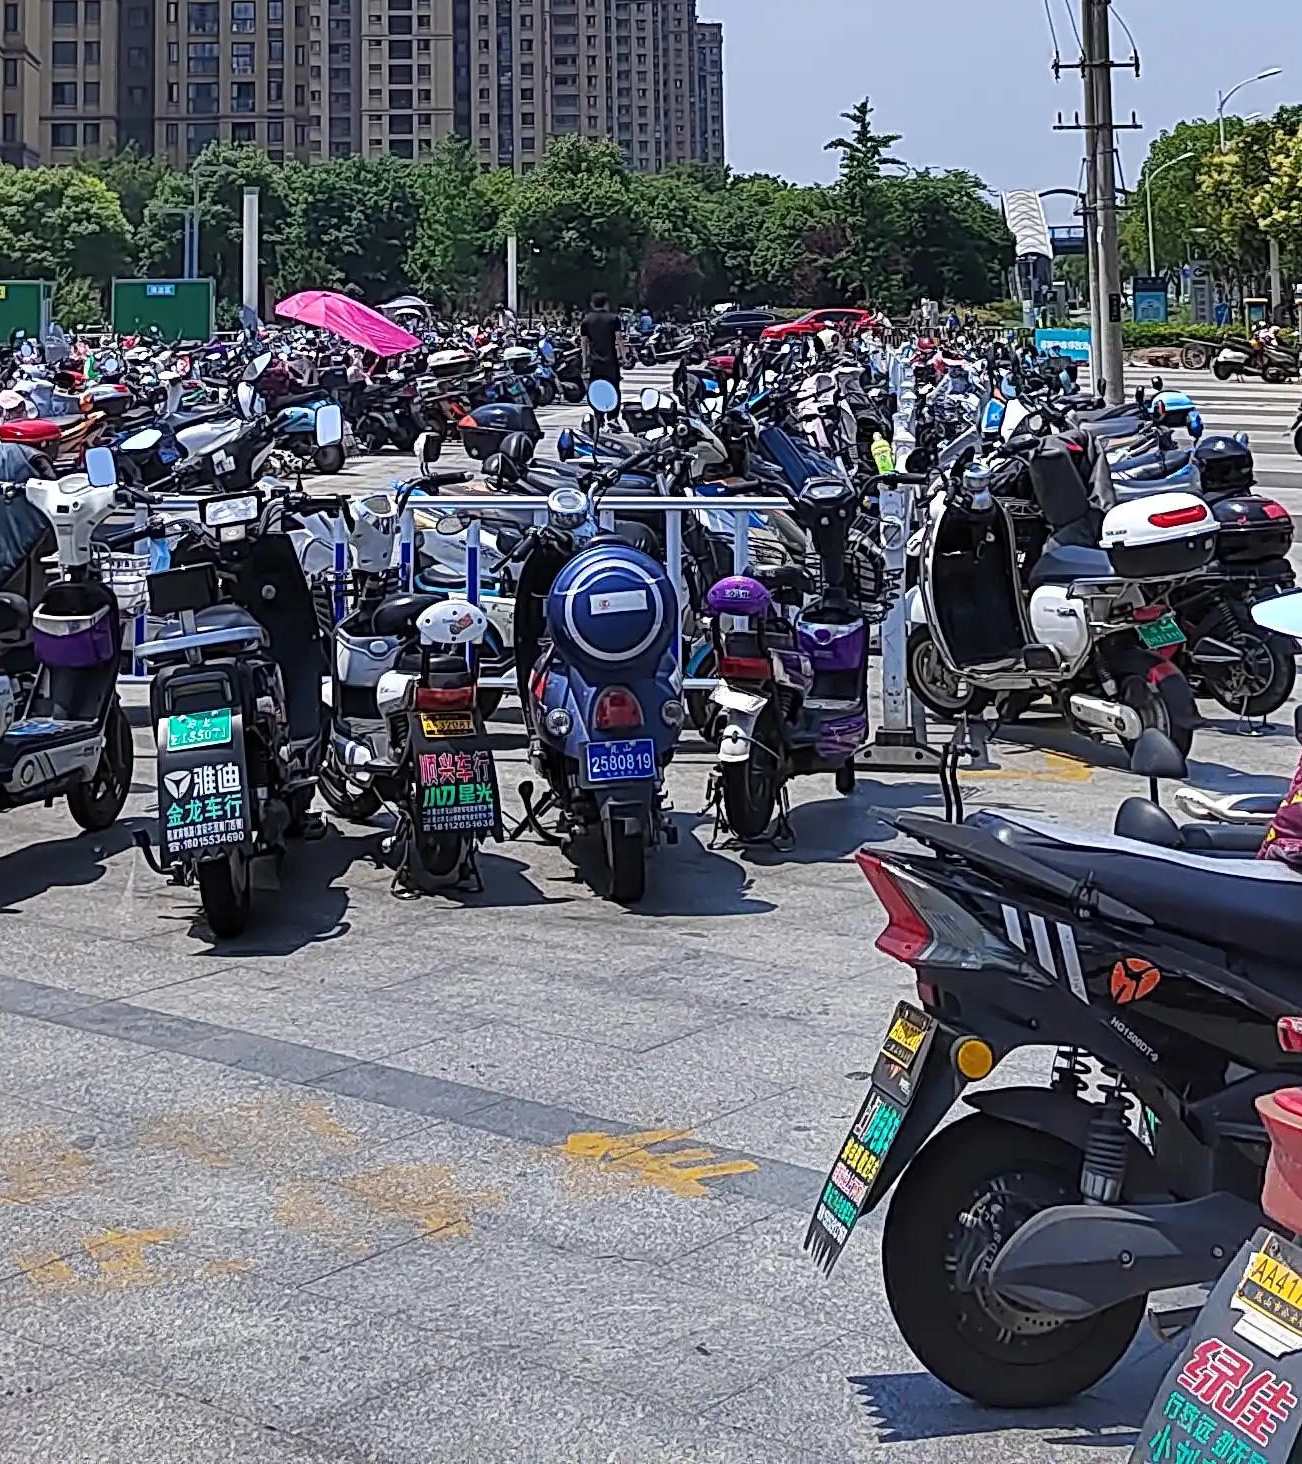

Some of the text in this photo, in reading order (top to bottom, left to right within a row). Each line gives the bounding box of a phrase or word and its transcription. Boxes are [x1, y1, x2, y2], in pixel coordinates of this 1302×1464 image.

[192, 761, 242, 798] 雅迪
[418, 749, 491, 787] 顺兴车行
[591, 752, 652, 773] 2580819
[166, 793, 243, 828] 金龙车行
[422, 782, 494, 808] 小刀 星光
[1176, 1337, 1298, 1448] 绿佳
